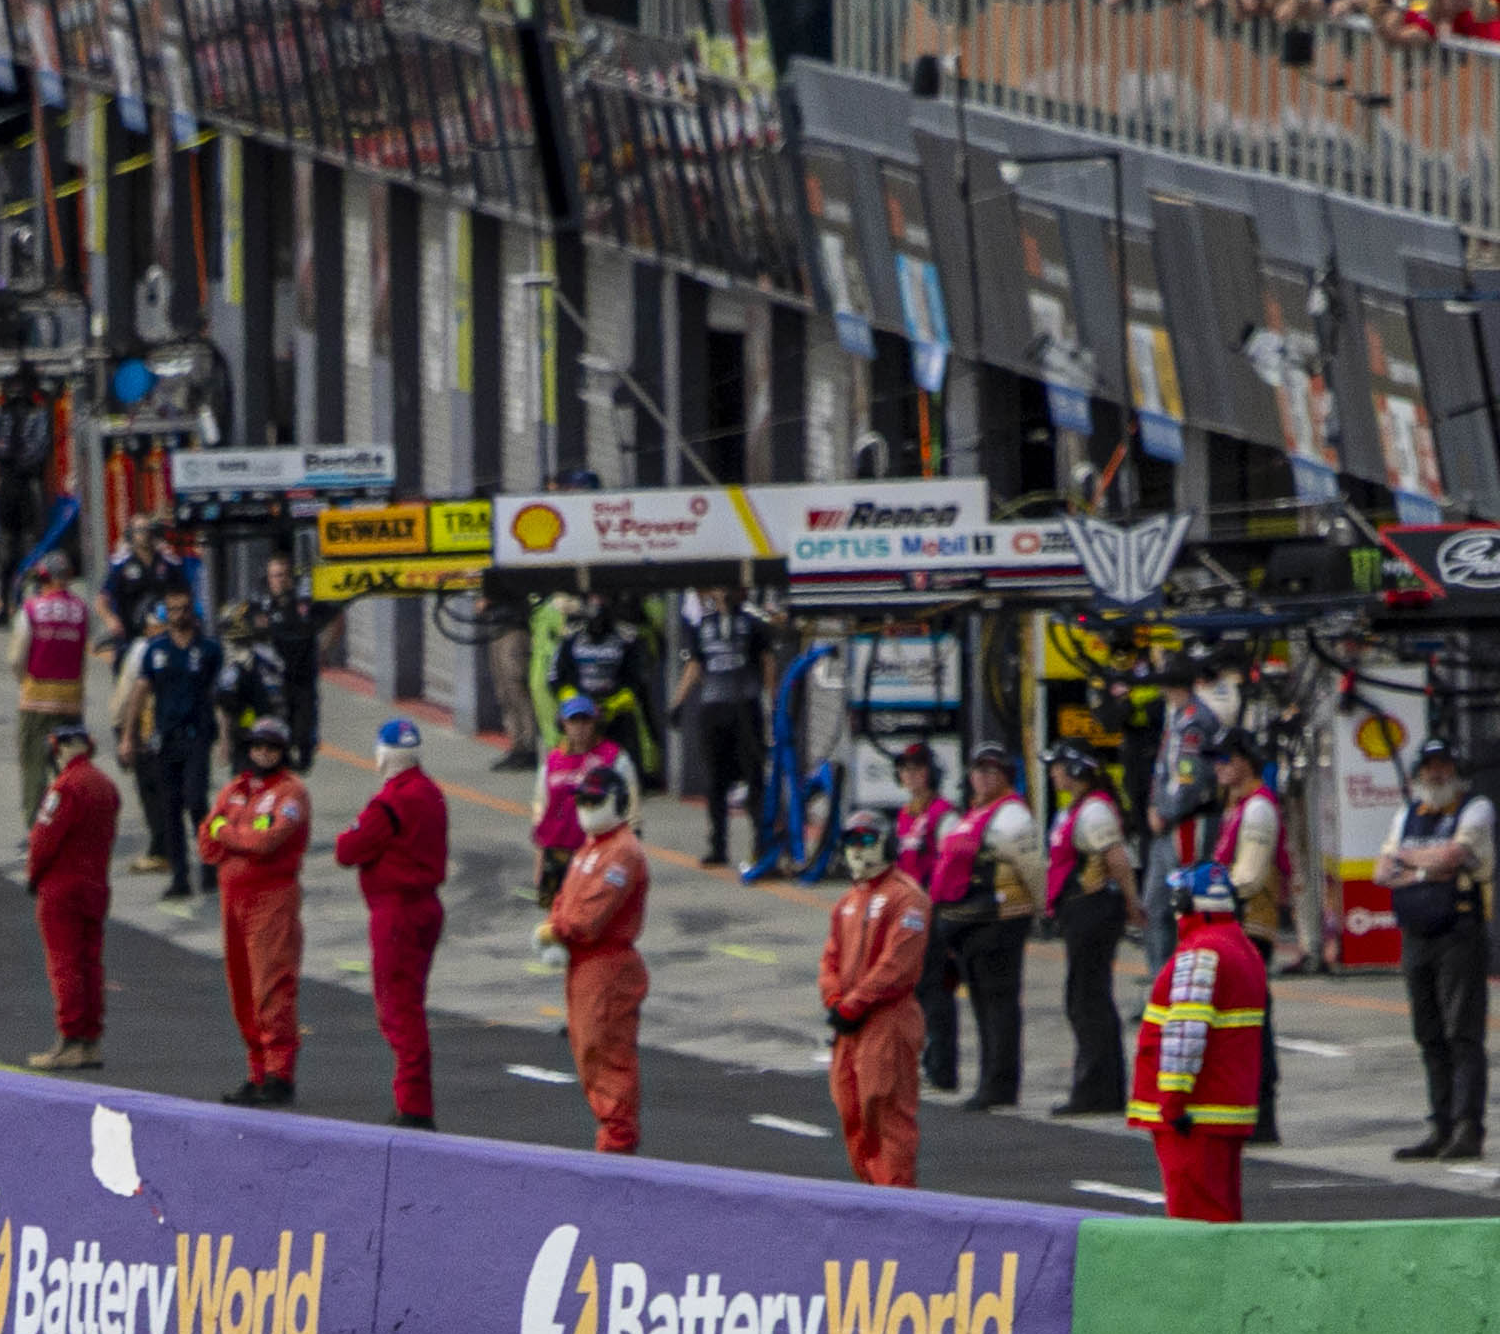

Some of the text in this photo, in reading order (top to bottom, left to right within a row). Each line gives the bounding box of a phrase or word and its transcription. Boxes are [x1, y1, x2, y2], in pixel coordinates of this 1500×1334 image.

[849, 500, 960, 529] Repco
[795, 534, 891, 561] OPTUS
[901, 534, 968, 558] Mobil
